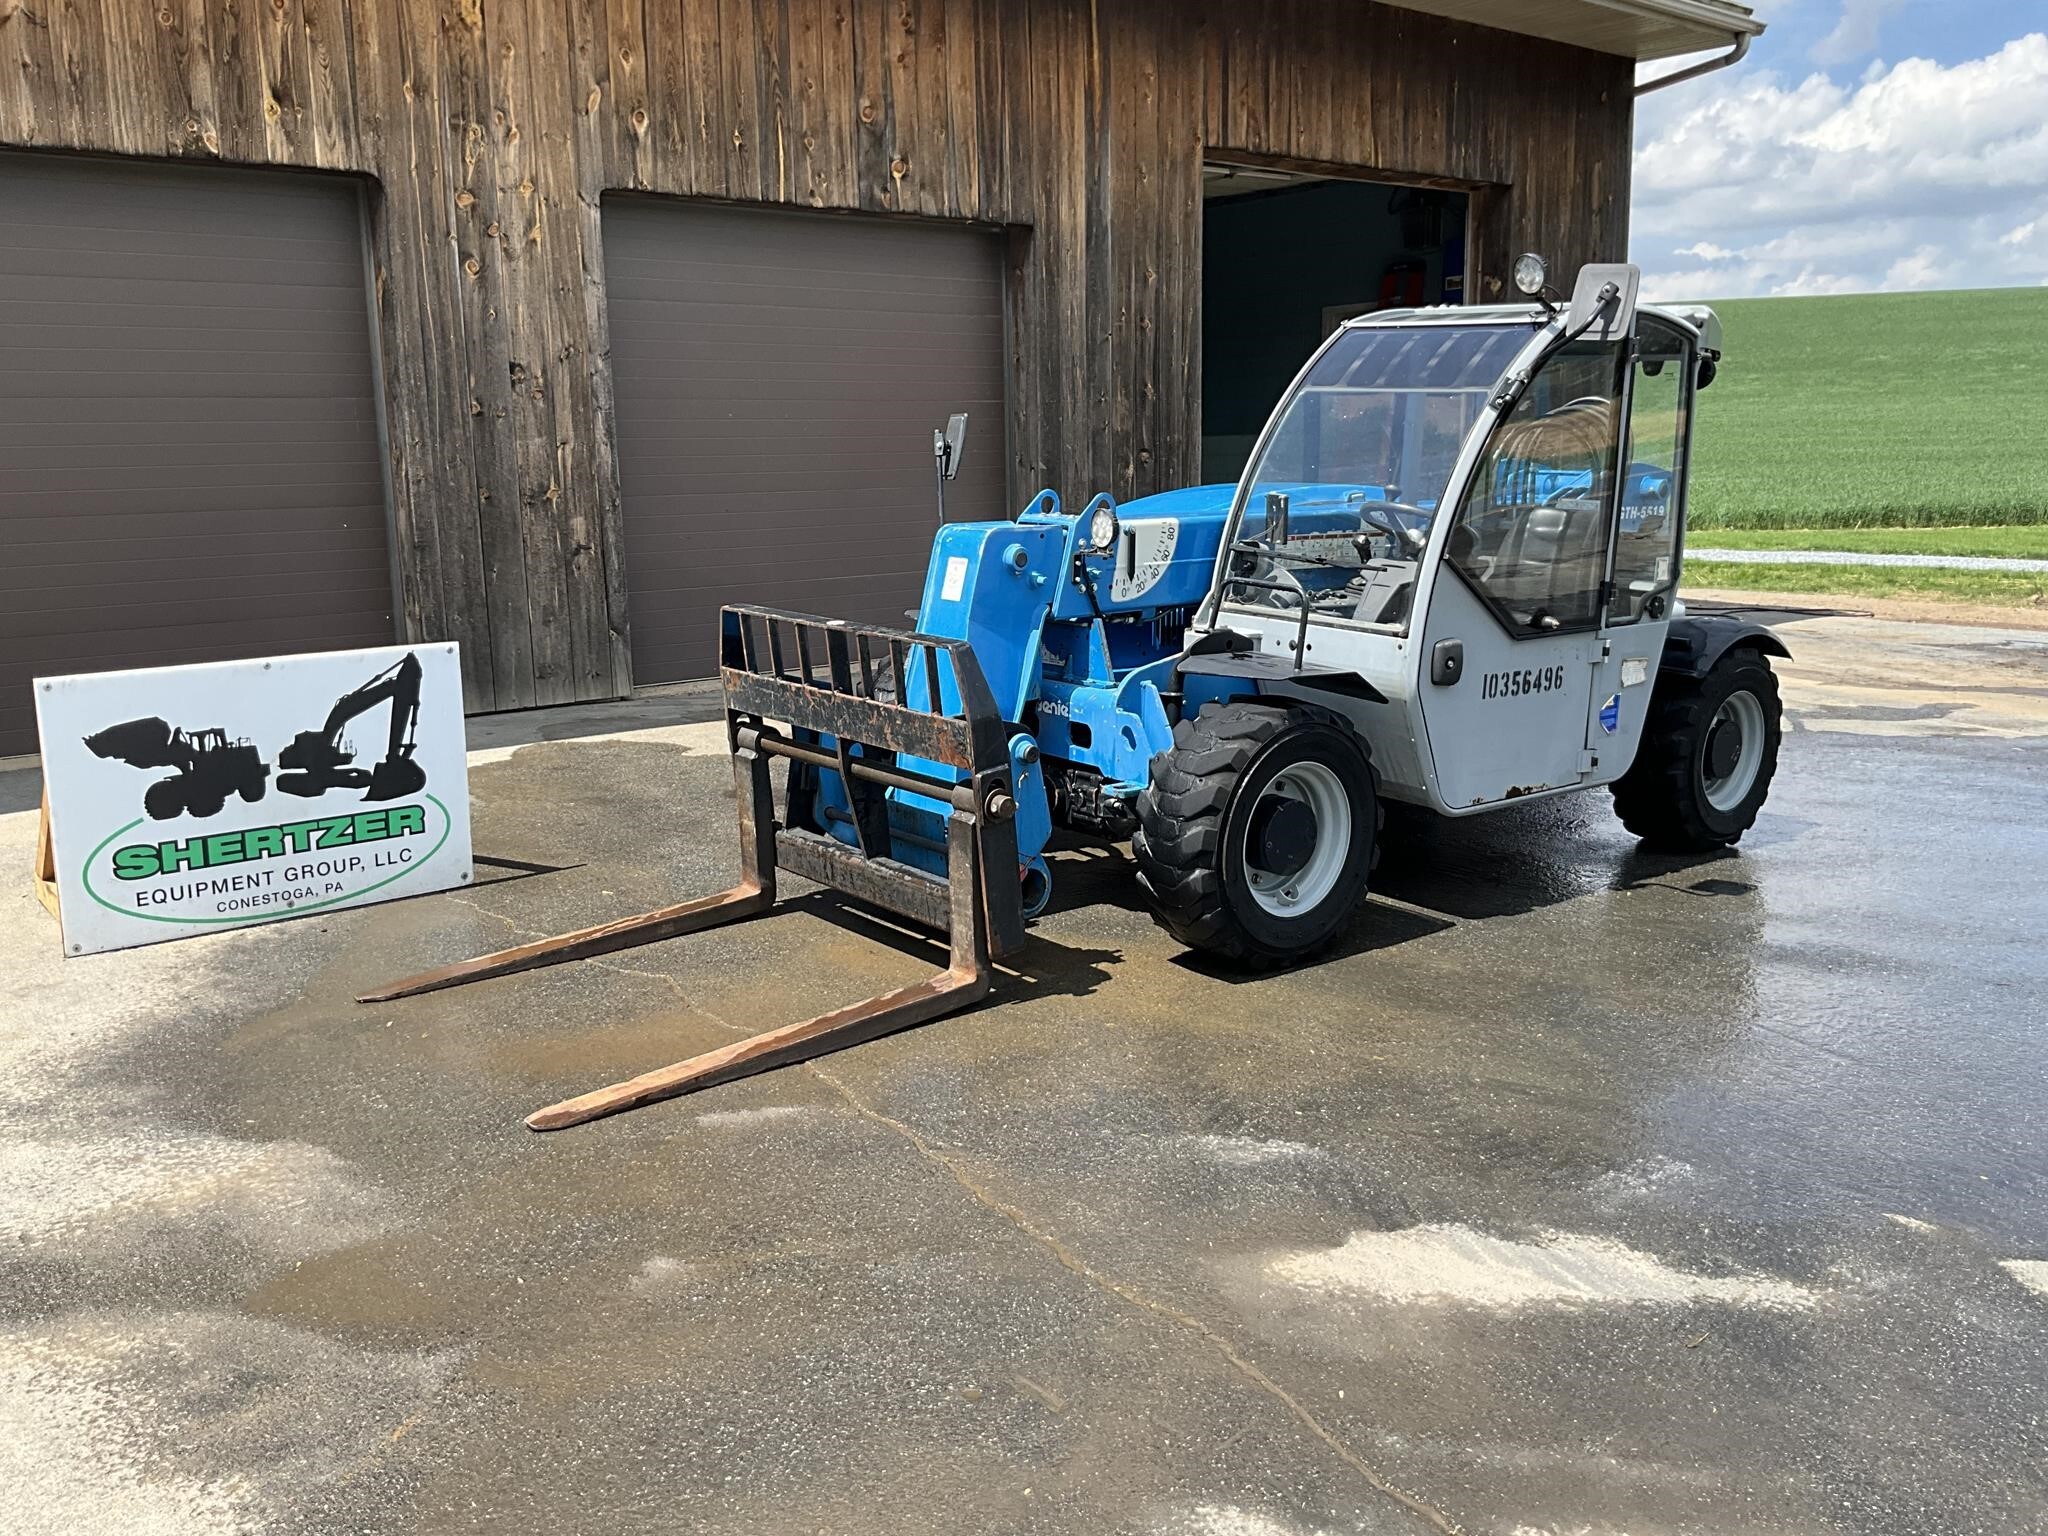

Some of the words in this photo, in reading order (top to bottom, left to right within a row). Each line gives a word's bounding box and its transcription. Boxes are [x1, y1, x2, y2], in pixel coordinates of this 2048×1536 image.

[1482, 665, 1564, 700] 10356496
[112, 804, 426, 881] SHERTZER
[136, 870, 275, 908] EQUIPMENT
[284, 856, 366, 882] GROUP,
[374, 848, 413, 868] LLC
[216, 888, 319, 913] CONESTOGA,
[325, 881, 344, 894] PA
